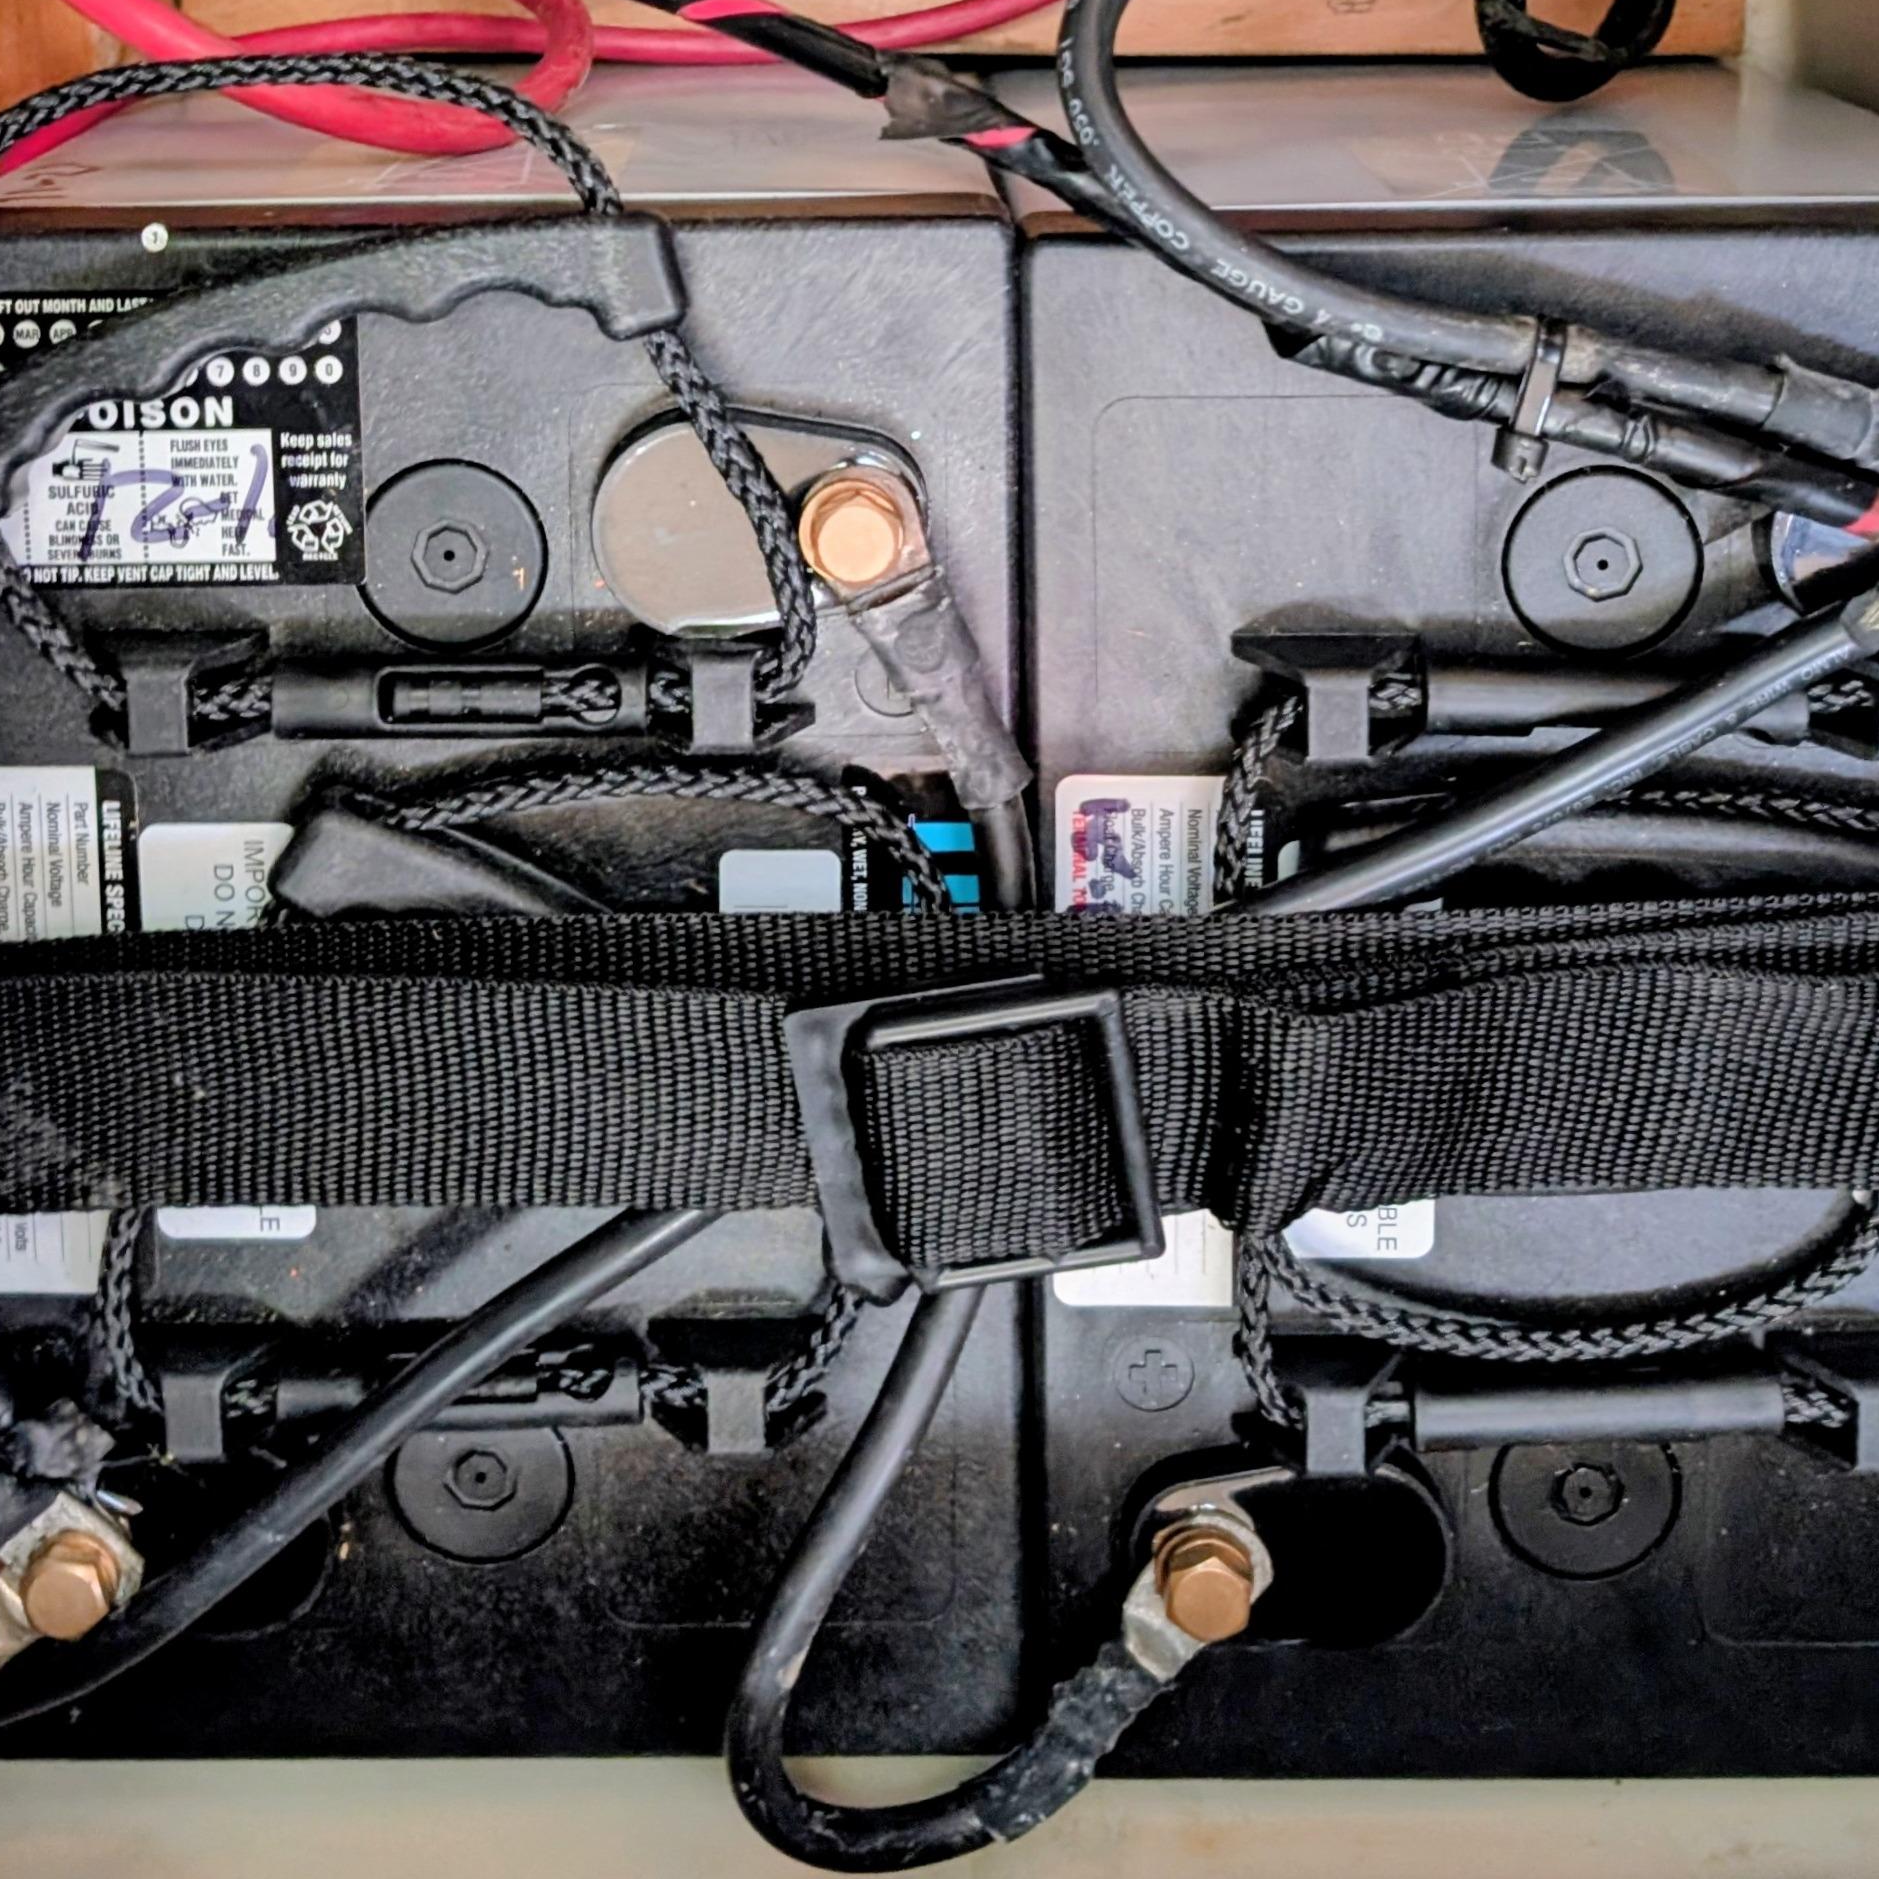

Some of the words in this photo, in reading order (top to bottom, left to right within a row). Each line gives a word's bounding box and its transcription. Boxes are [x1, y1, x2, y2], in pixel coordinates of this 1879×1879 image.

[1105, 164, 1190, 251] COPPER
[1211, 258, 1306, 315] GAUGE
[15, 299, 39, 315] OUT
[43, 298, 86, 314] MONTH
[89, 298, 114, 313] AND
[15, 328, 40, 341] MAR
[170, 439, 201, 452] FLUSH
[204, 439, 228, 452] EYES
[280, 432, 313, 450] Keep
[317, 432, 352, 448] sales
[171, 456, 239, 469] IMMEDIATELY
[281, 452, 328, 471] receipt
[330, 452, 349, 468] for
[172, 474, 197, 487] WITH
[201, 473, 238, 486] WATER.
[289, 472, 347, 490] warranty
[55, 520, 76, 532] CAN
[106, 534, 120, 546] OR
[221, 543, 250, 557] FAST.
[34, 568, 58, 584] NOT
[61, 567, 83, 583] TIP.
[85, 566, 115, 583] KEEP
[118, 565, 147, 582] VENT
[150, 565, 174, 581] CAP
[176, 565, 211, 581] TIGHT
[212, 564, 238, 580] AND
[240, 564, 280, 580] LEVEL.
[18, 802, 34, 854] Ampere
[46, 802, 62, 857] Nominal
[74, 802, 89, 833] Part
[102, 800, 124, 881] LIFELINE
[1130, 808, 1147, 889] Bulk/Absorb
[1158, 808, 1174, 860] Ampere
[1187, 809, 1203, 864] Nominal
[21, 857, 35, 889] Hour
[76, 834, 92, 885] Number
[851, 848, 867, 880] WET,
[48, 858, 64, 908] Voltage
[214, 863, 235, 902] DO
[1159, 862, 1174, 895] Hour
[1187, 864, 1203, 915] Voltage
